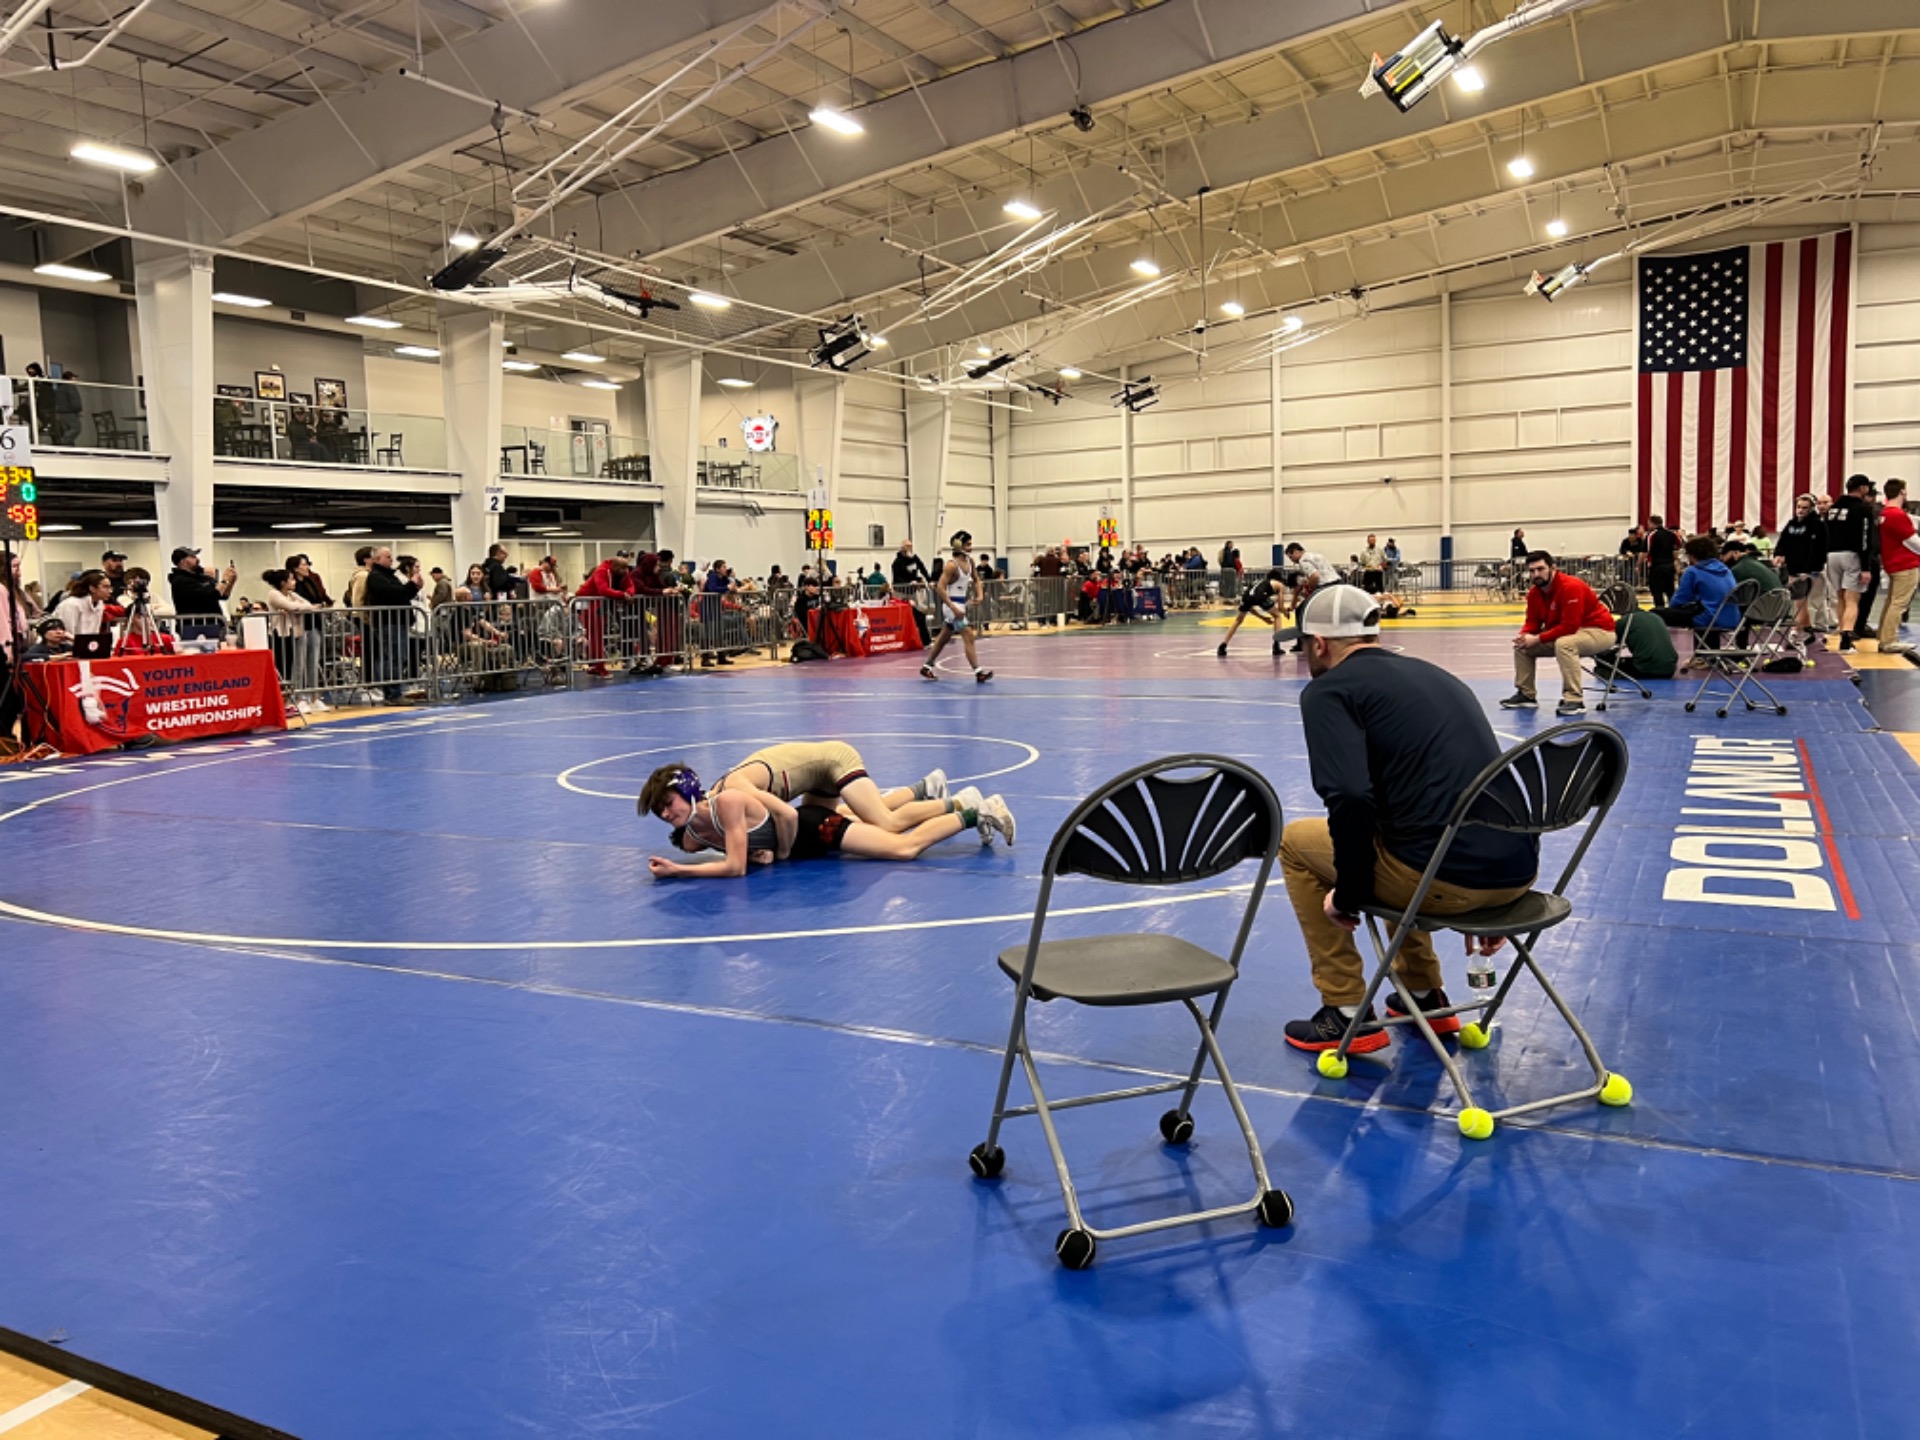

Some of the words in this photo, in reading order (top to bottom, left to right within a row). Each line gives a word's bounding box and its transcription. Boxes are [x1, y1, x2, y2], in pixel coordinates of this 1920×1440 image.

[0, 428, 15, 450] 6
[22, 483, 36, 502] 0
[490, 496, 498, 511] 2
[143, 667, 194, 681] YOUTH
[145, 684, 179, 698] NEW
[184, 677, 251, 694] ENGLAND
[145, 695, 229, 714] WRESTLING
[146, 705, 262, 730] CHAMPIONSHIPS
